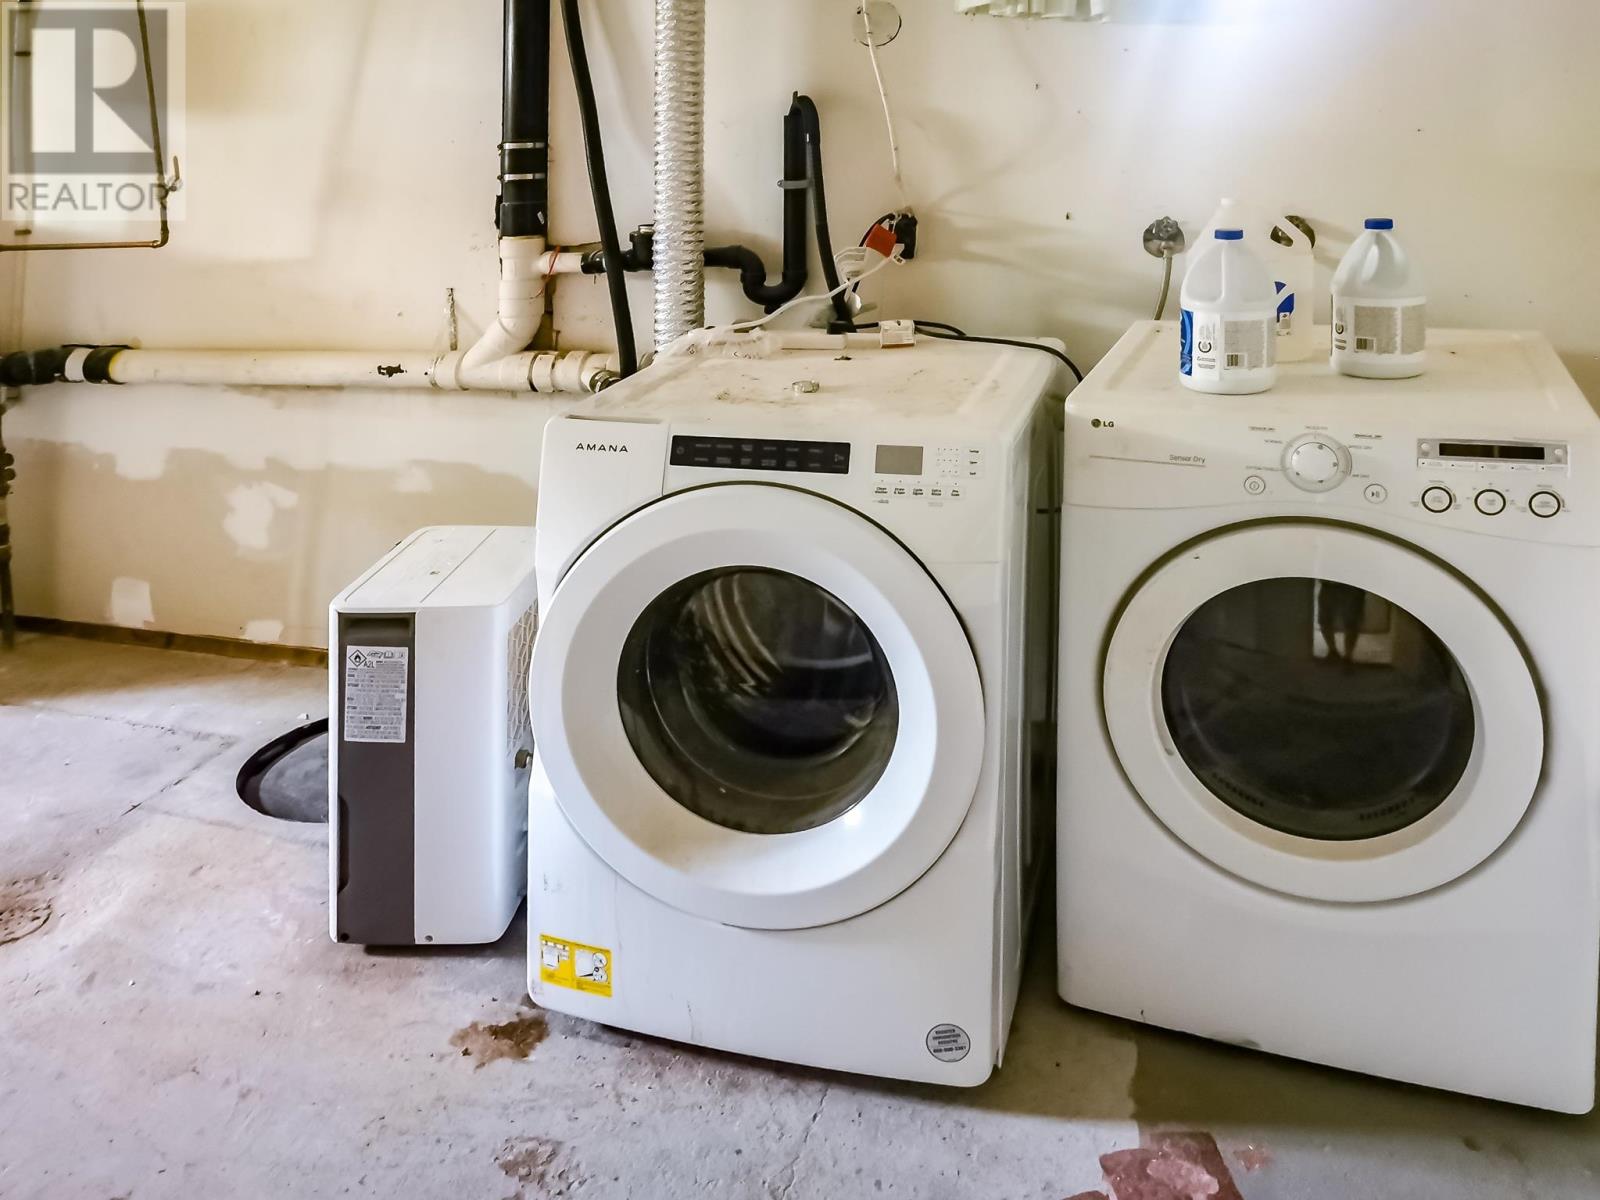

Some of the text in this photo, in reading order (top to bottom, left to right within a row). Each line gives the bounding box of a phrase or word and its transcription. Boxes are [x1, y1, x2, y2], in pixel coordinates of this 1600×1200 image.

[575, 442, 629, 453] AMANA
[1169, 454, 1206, 464] Sensor Dry
